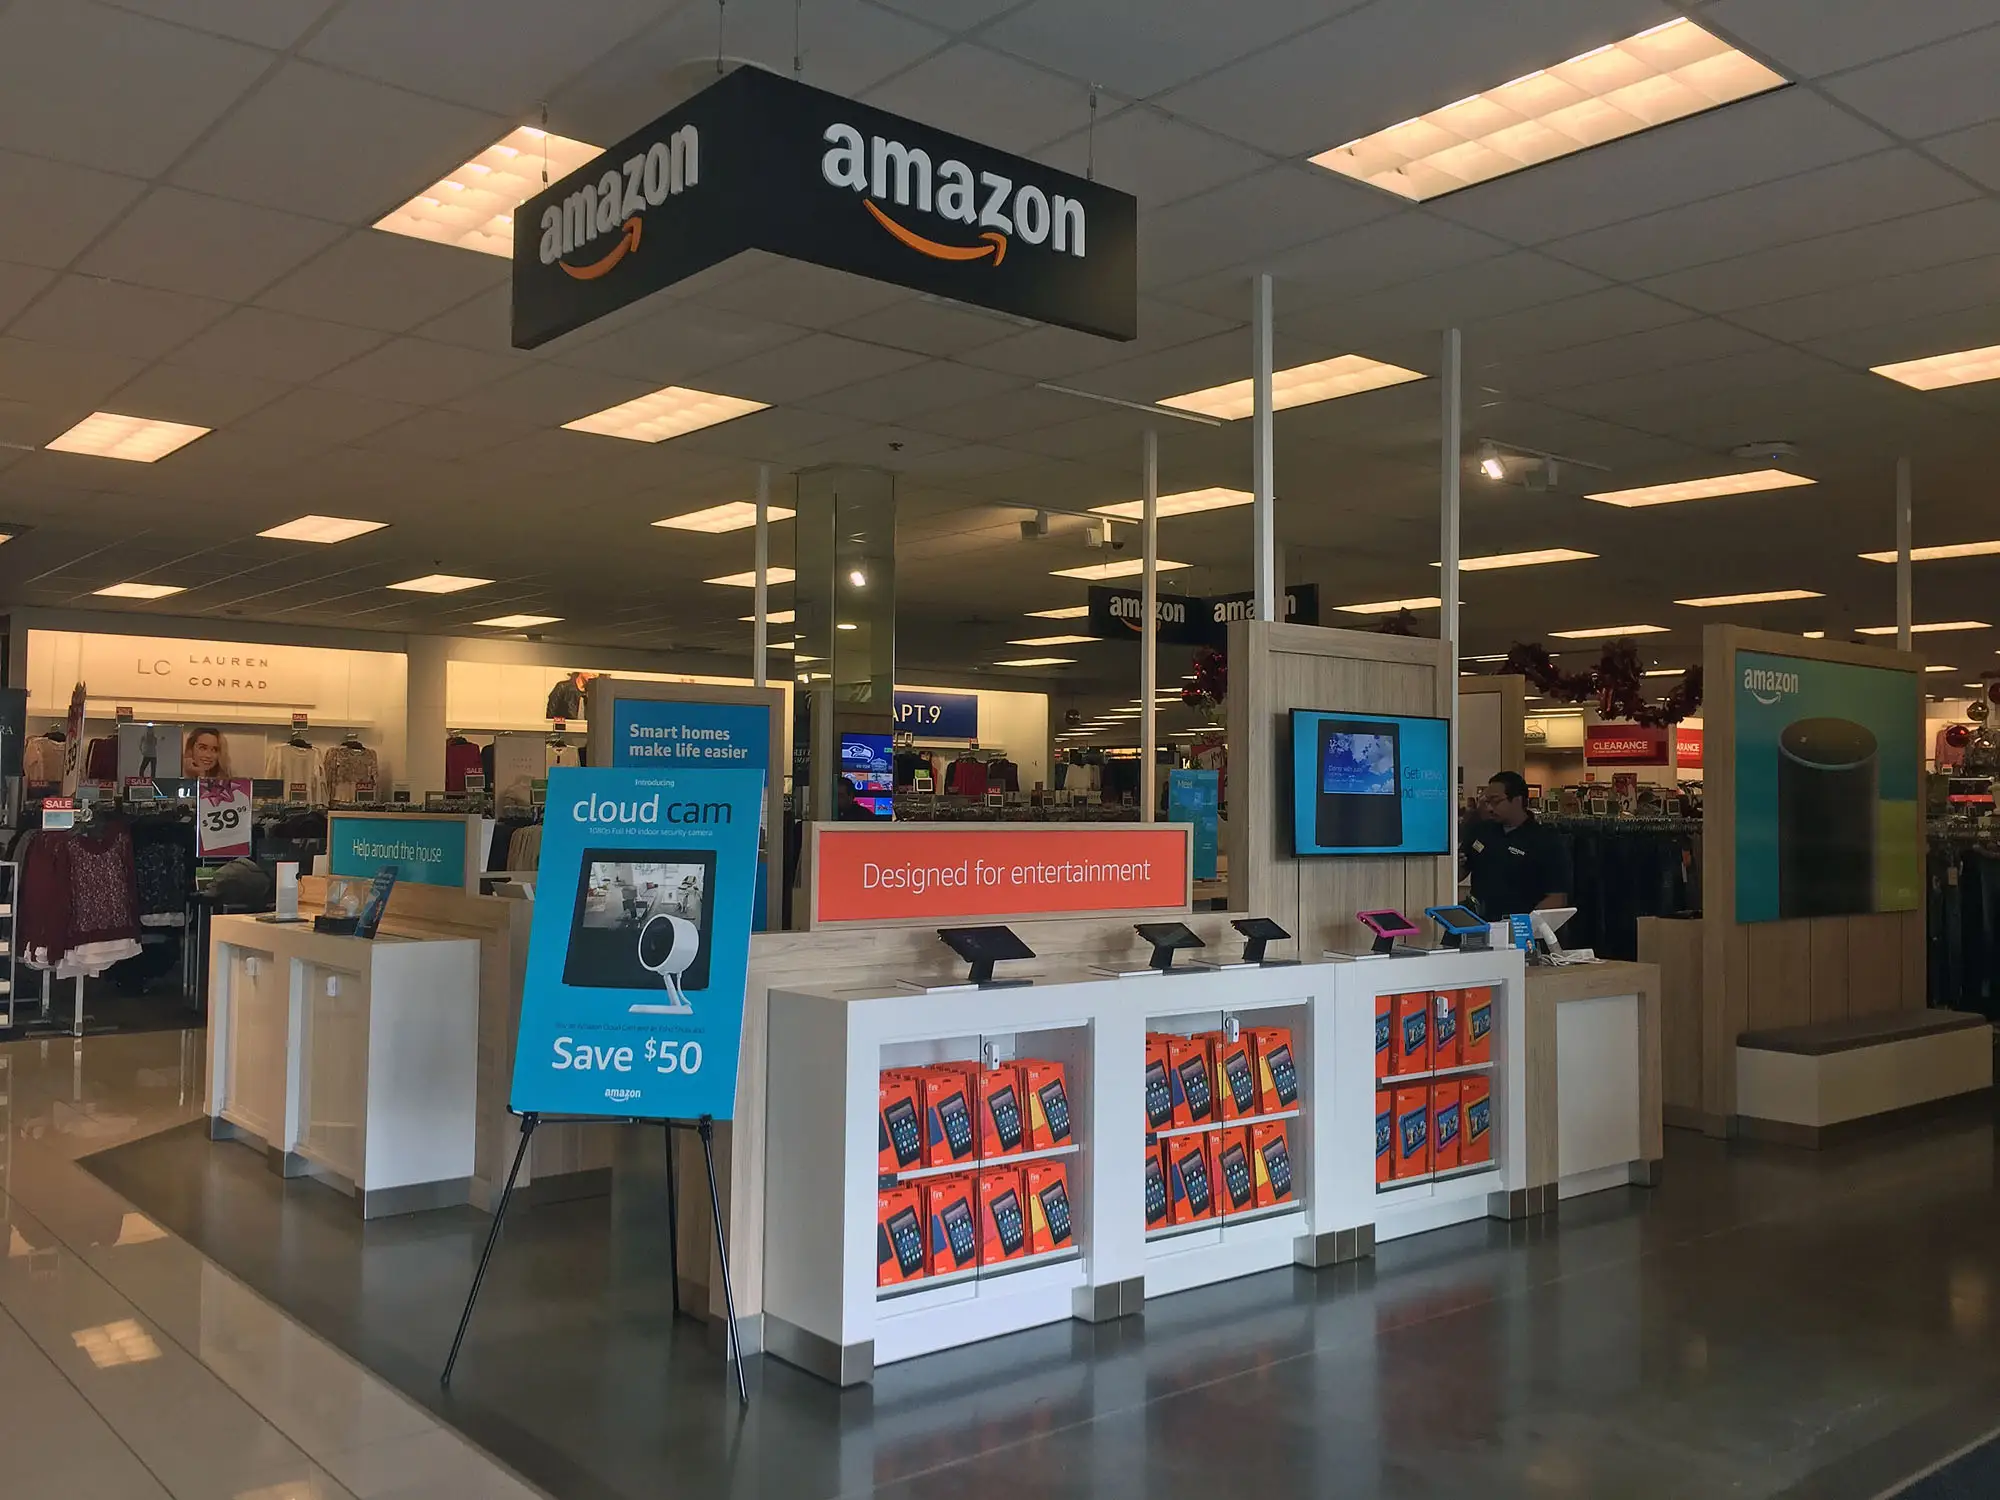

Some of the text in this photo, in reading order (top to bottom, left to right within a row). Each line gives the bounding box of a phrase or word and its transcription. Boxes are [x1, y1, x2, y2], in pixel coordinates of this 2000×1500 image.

[539, 124, 699, 265] amazon
[822, 122, 1086, 258] amazon
[137, 658, 171, 676] LC
[189, 654, 268, 668] LAUREN
[188, 677, 267, 690] CONRAD
[1744, 668, 1799, 693] amazon
[629, 723, 730, 741] Smart homes
[629, 742, 748, 759] make life easier
[1592, 740, 1648, 750] CLEARANCE
[1404, 766, 1421, 780] Get
[635, 778, 675, 788] Introducing
[45, 799, 72, 809] SALE
[572, 792, 733, 824] cloud cam
[638, 827, 659, 836] indoor
[660, 828, 687, 838] security
[352, 838, 442, 862] Help around the house
[863, 858, 1151, 895] Designed for entertainment
[551, 1036, 703, 1074] Save $50
[604, 1088, 642, 1098] amazon
